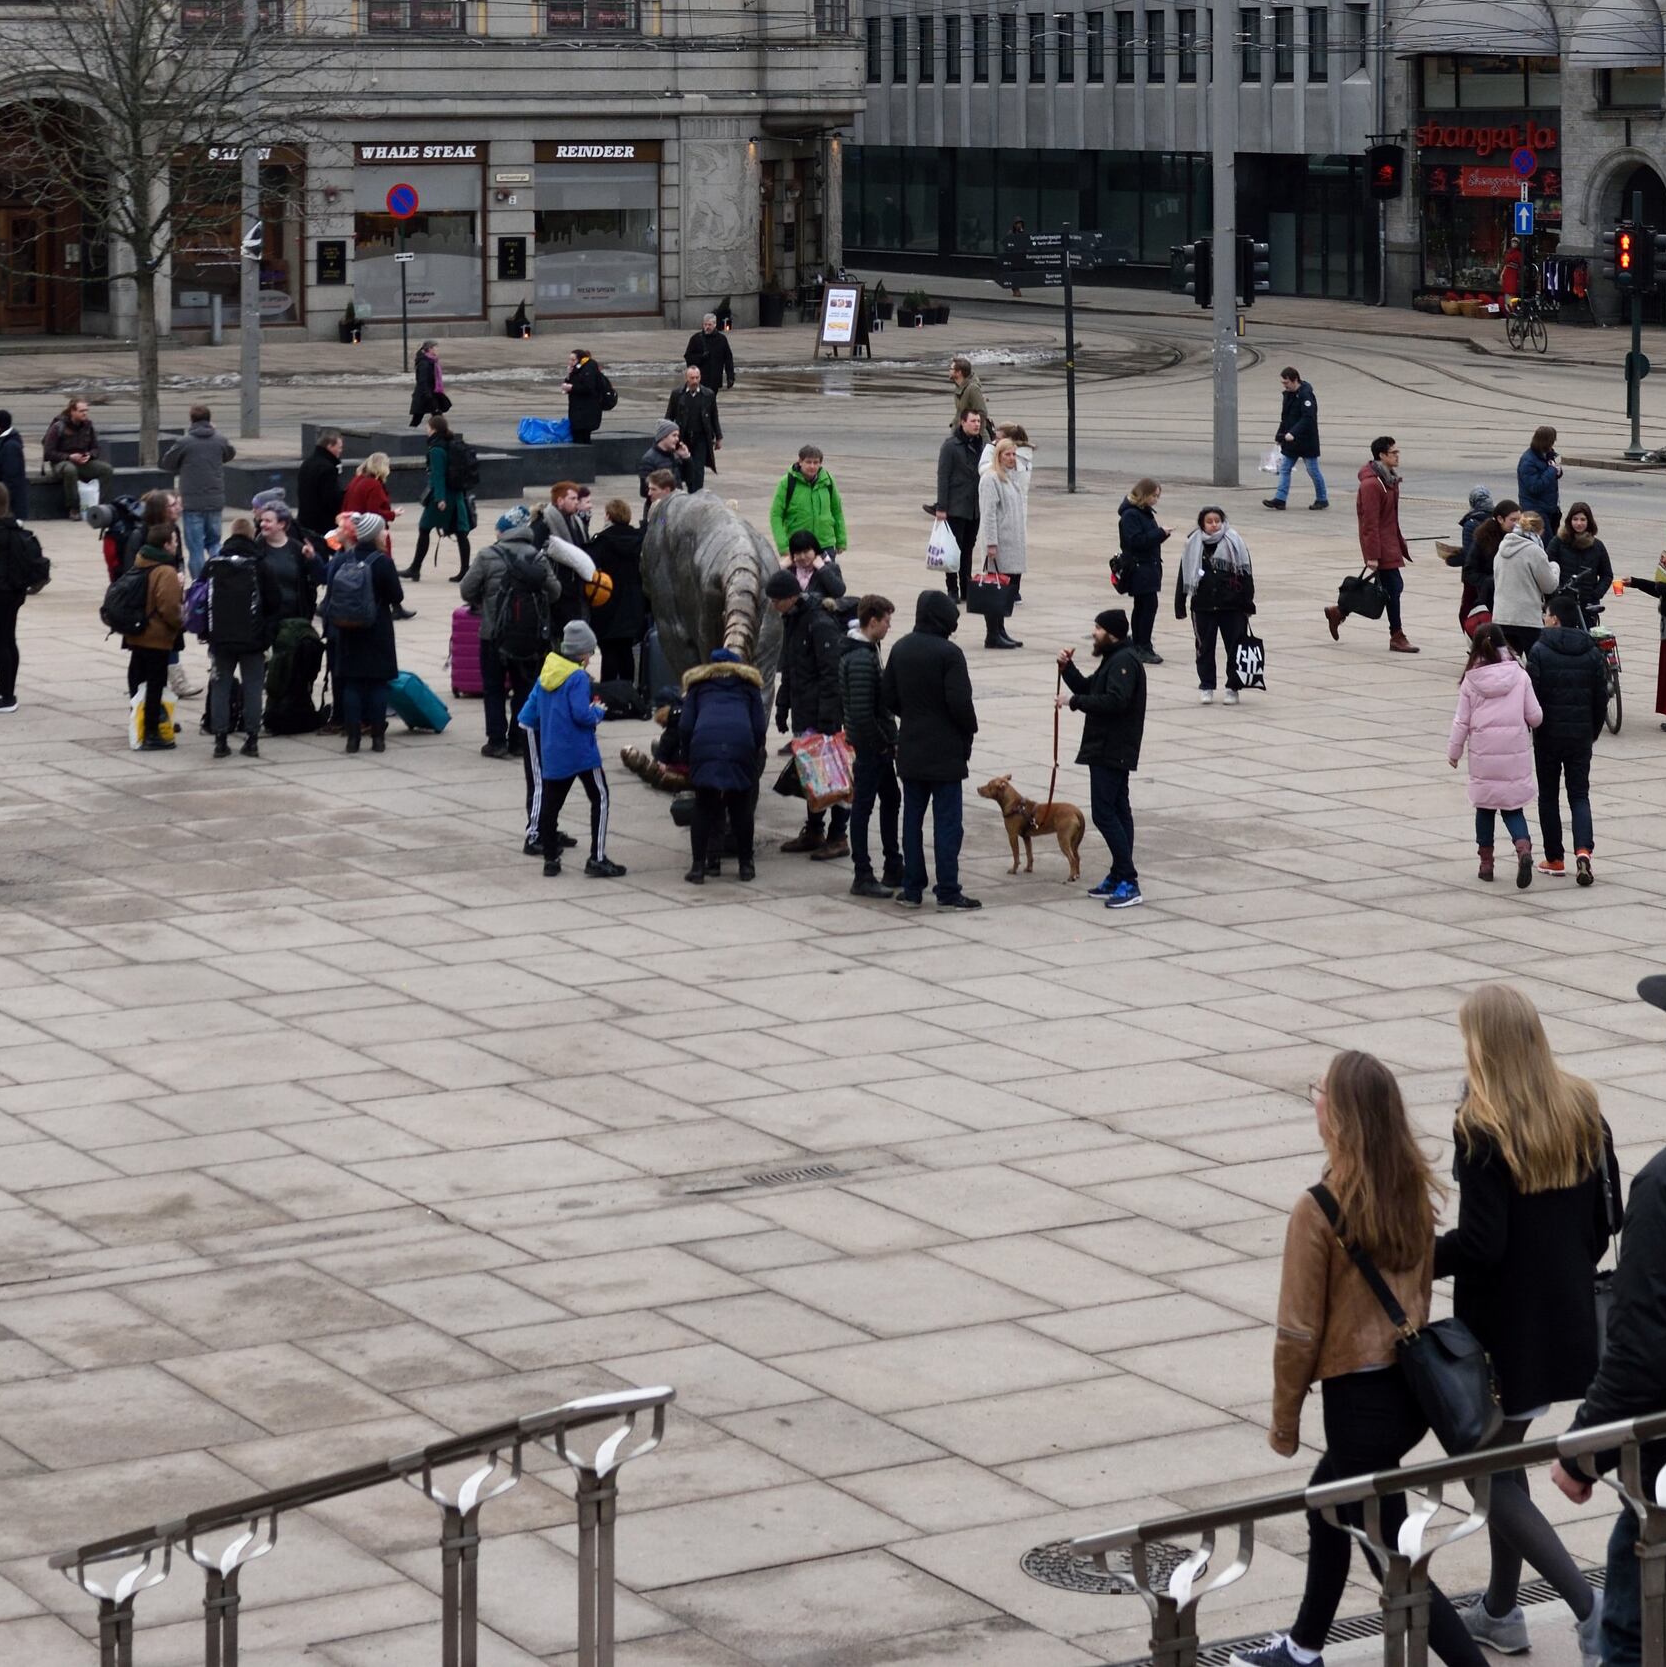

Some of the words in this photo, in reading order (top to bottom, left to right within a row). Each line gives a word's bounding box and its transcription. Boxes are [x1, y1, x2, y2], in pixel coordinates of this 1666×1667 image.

[361, 146, 420, 159] WHALE
[423, 145, 478, 159] STEAK
[556, 145, 635, 158] REINDEER
